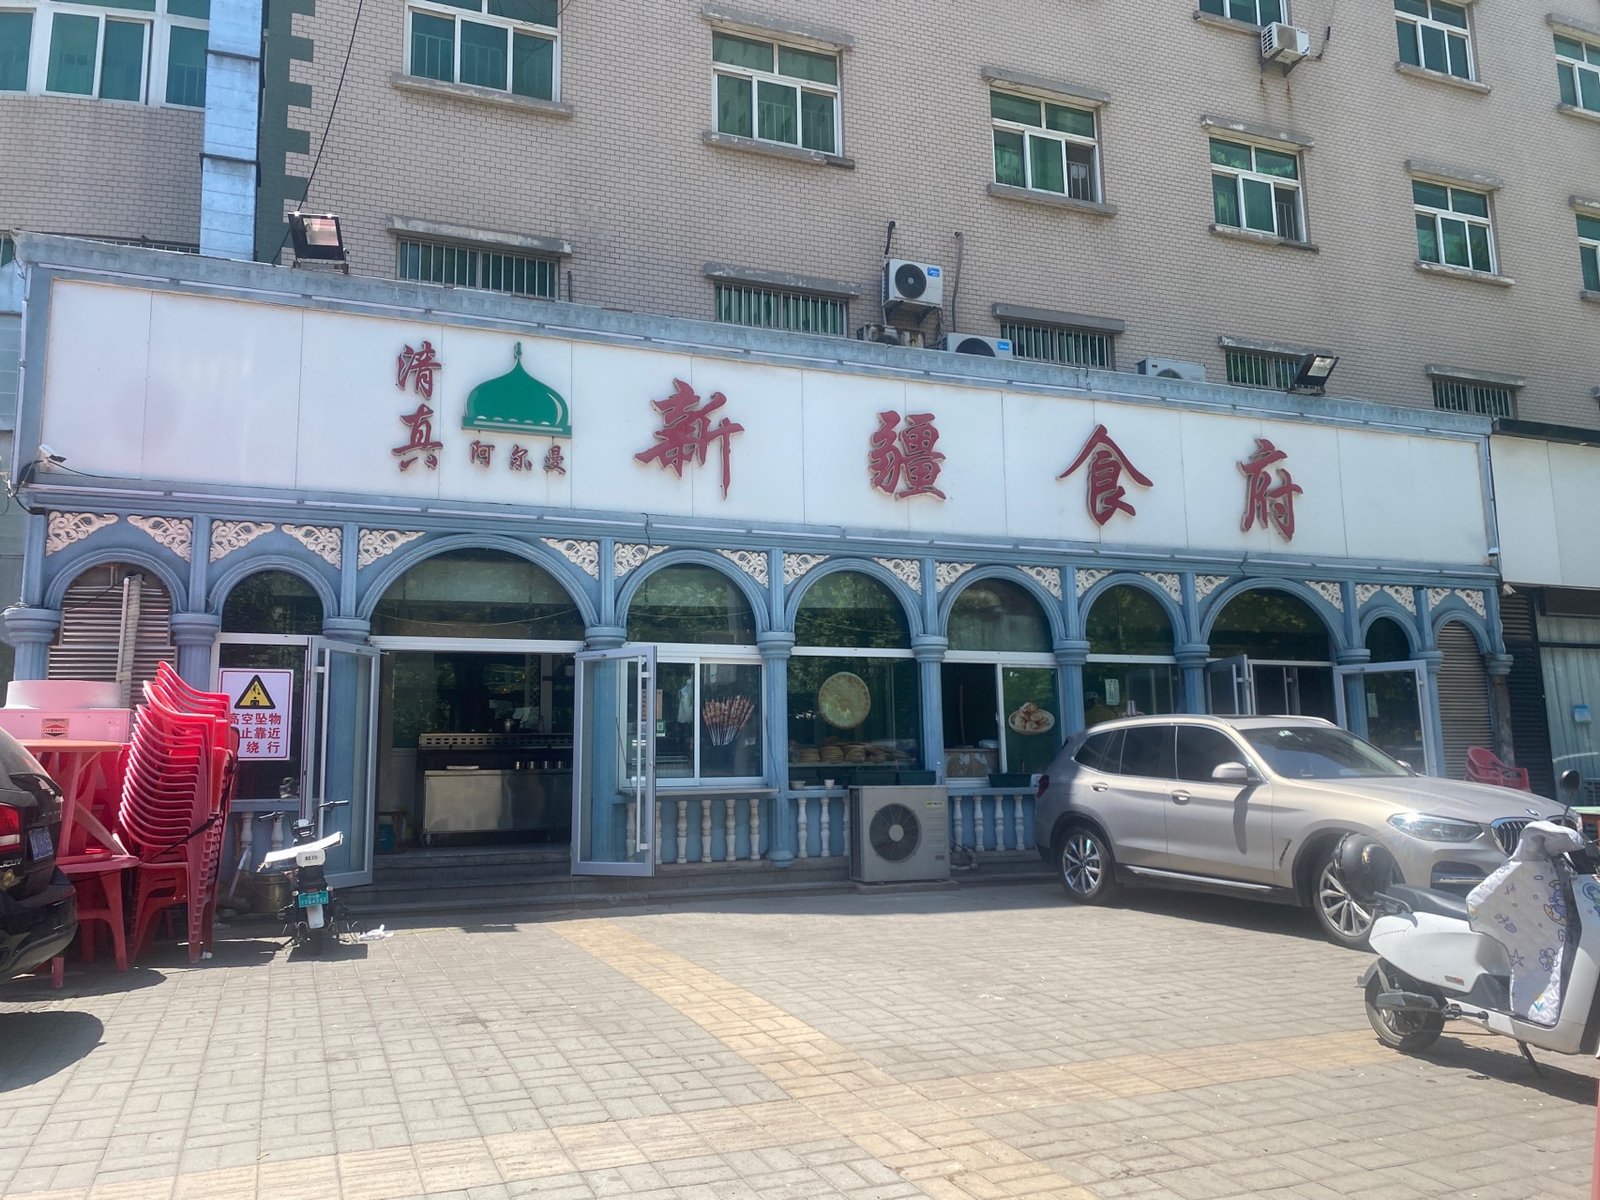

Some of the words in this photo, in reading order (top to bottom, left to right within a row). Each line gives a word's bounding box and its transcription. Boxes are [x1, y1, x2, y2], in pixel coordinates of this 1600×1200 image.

[391, 340, 443, 471] 清真
[469, 440, 567, 475] 阿尔曼
[635, 377, 1303, 543] 新疆食府
[229, 713, 281, 725] 高空坠物
[240, 727, 280, 739] 止靠近
[246, 741, 281, 753] 绕行
